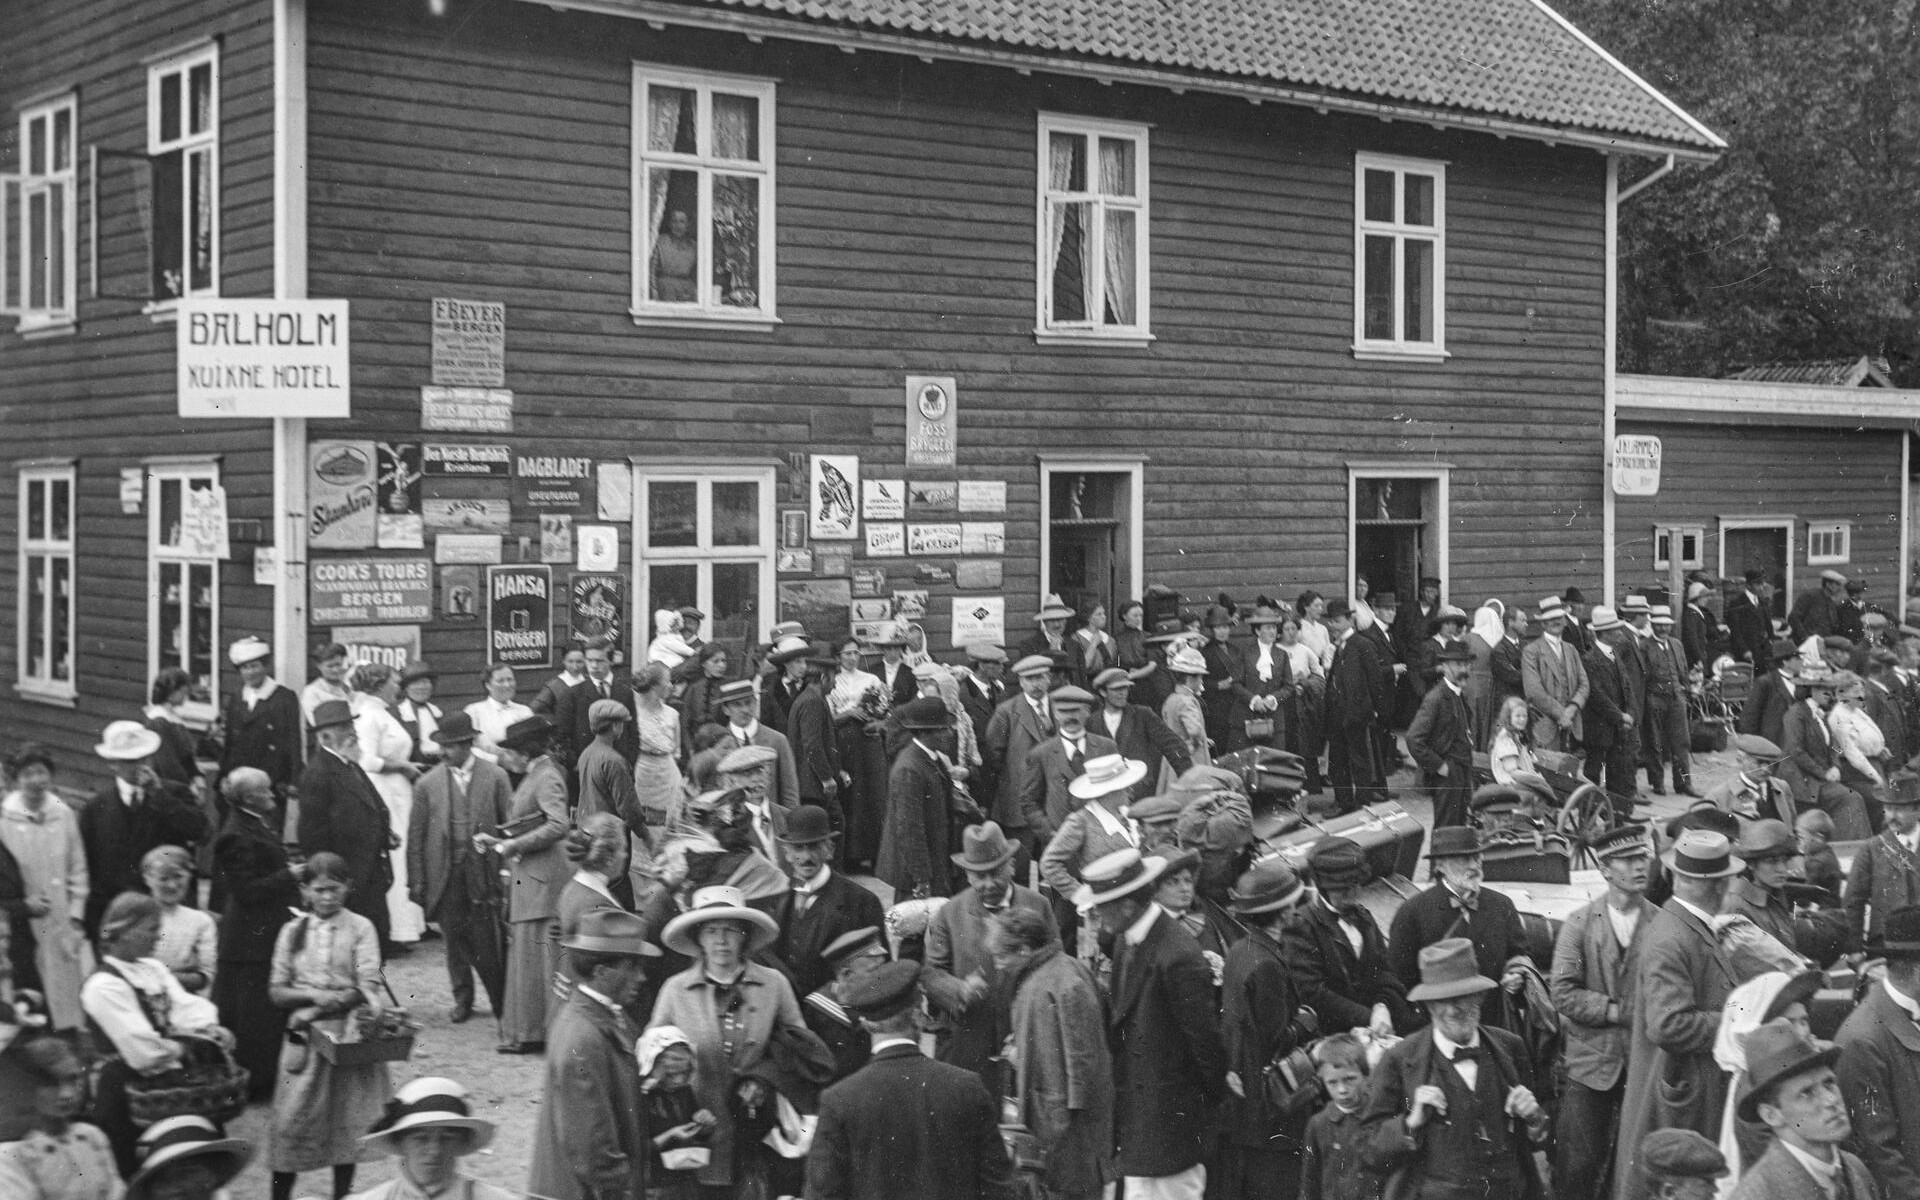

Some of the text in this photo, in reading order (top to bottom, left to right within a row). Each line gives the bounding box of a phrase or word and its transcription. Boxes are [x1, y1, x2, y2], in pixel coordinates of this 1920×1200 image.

[448, 301, 504, 322] BEYER
[189, 312, 337, 346] BALHOLM
[453, 321, 503, 333] BERGEN
[273, 364, 341, 389] HOTEL
[919, 422, 946, 437] FOSS
[518, 456, 592, 478] DAGBLADET
[374, 562, 428, 579] TOURS
[494, 574, 546, 601] HANSA
[341, 592, 403, 606] BERGEN
[494, 630, 547, 649] BRYGGERI
[342, 644, 407, 671] MOTOR
[500, 650, 543, 661] BERGEN
